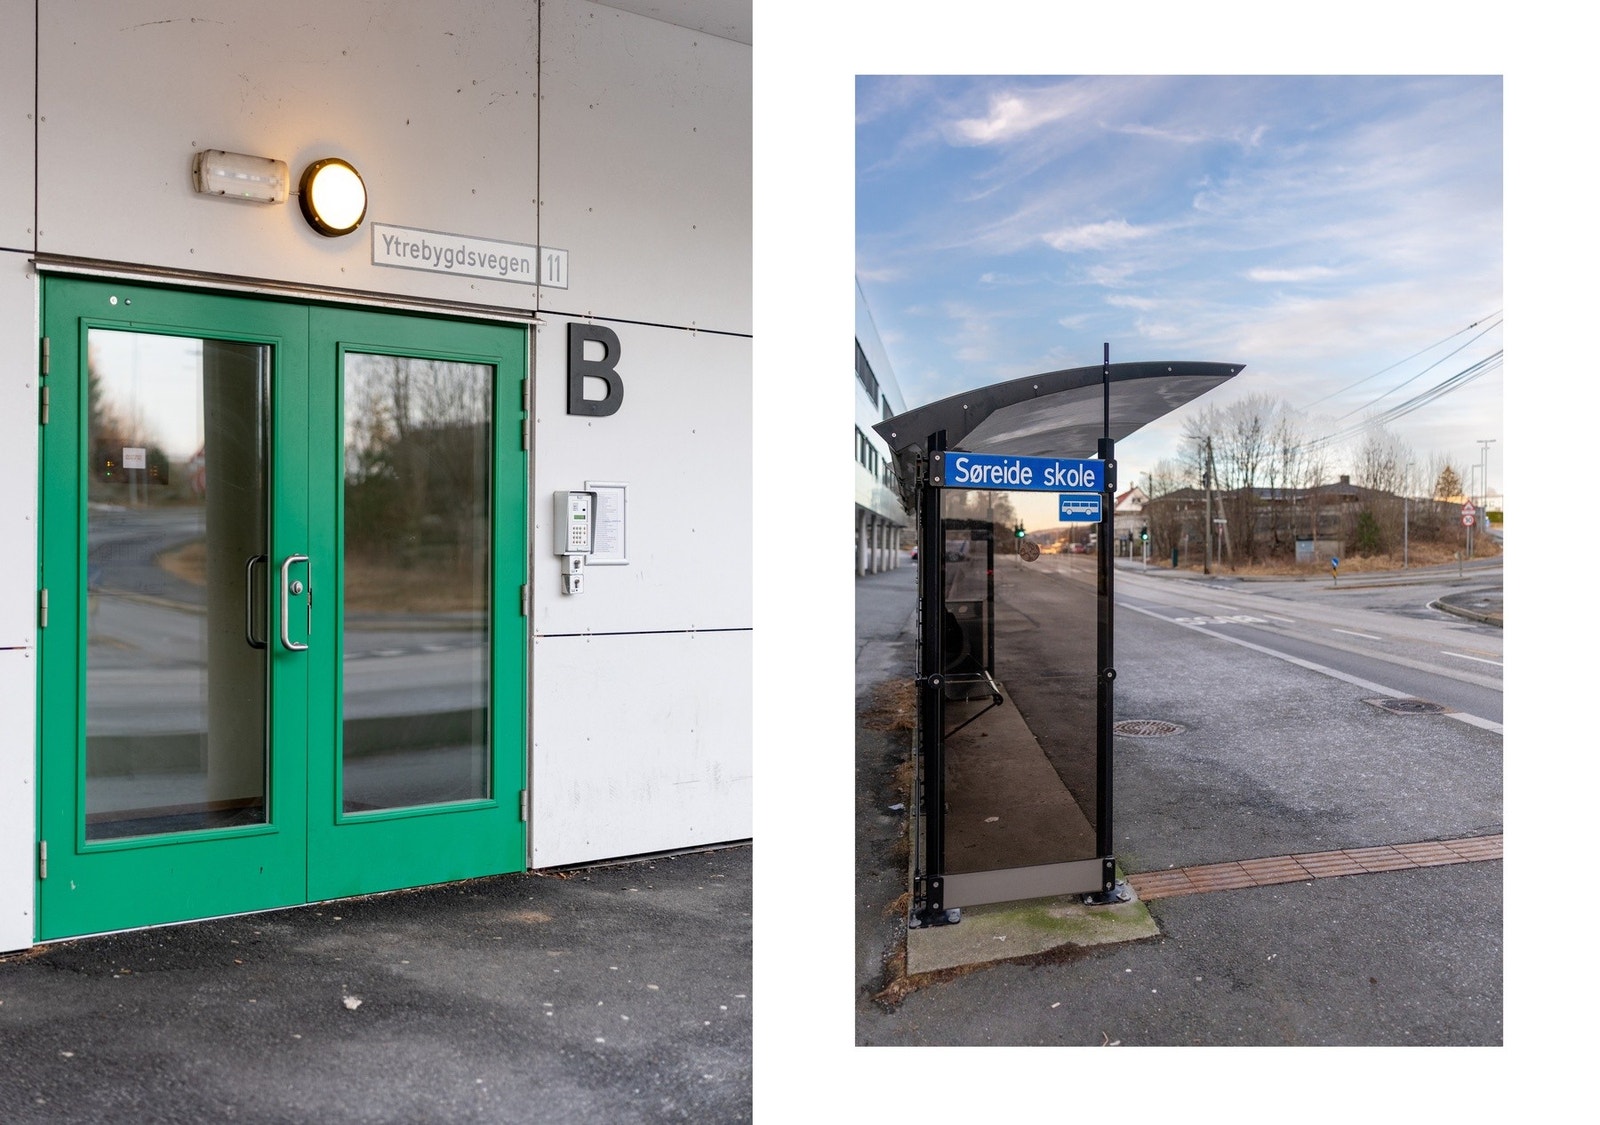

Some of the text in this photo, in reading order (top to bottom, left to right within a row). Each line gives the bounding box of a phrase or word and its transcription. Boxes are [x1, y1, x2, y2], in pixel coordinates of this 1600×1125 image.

[382, 233, 561, 282] Ytrebygdsvegen 11
[566, 322, 624, 417] B
[955, 457, 1096, 488] Søreide skole
